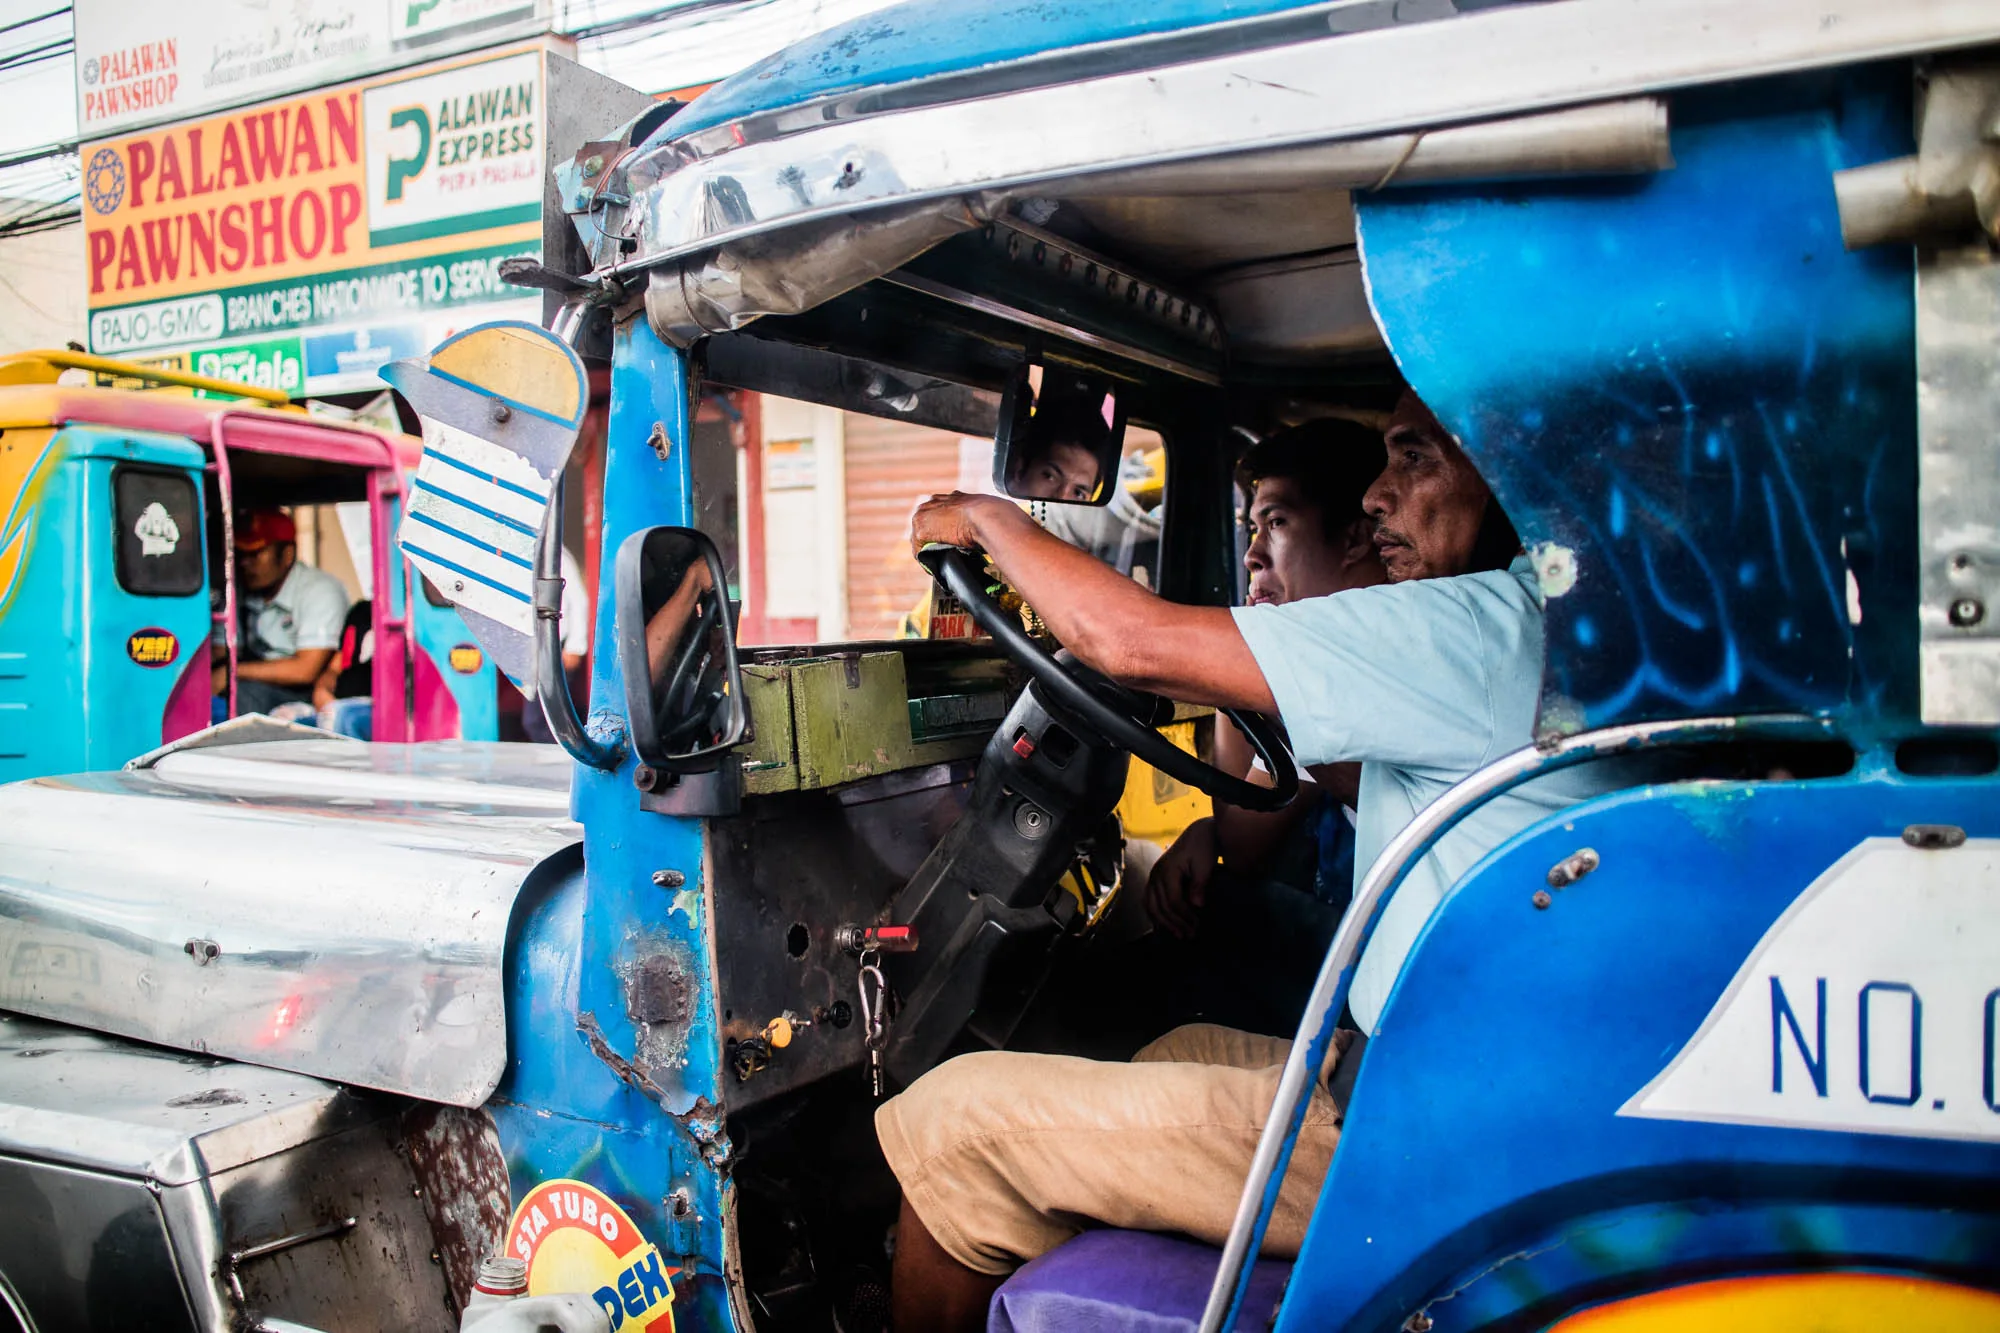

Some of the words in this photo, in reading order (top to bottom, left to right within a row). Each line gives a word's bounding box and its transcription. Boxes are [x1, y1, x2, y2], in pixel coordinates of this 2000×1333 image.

[100, 37, 178, 84] PALAWAN
[85, 72, 178, 121] PAWNSHOP
[127, 93, 358, 208] PALAWAN
[438, 122, 533, 167] EXPRESS
[88, 182, 362, 294] PAWNSHOP
[101, 302, 213, 346] PAJO-GMC
[227, 285, 312, 332] BRANCHES
[314, 266, 419, 320] NATIONWIDE
[419, 264, 448, 303] TO
[449, 256, 505, 301] SERVE
[931, 615, 968, 639] PARK
[1769, 975, 1945, 1111] NO.
[548, 1190, 618, 1241] TUBO
